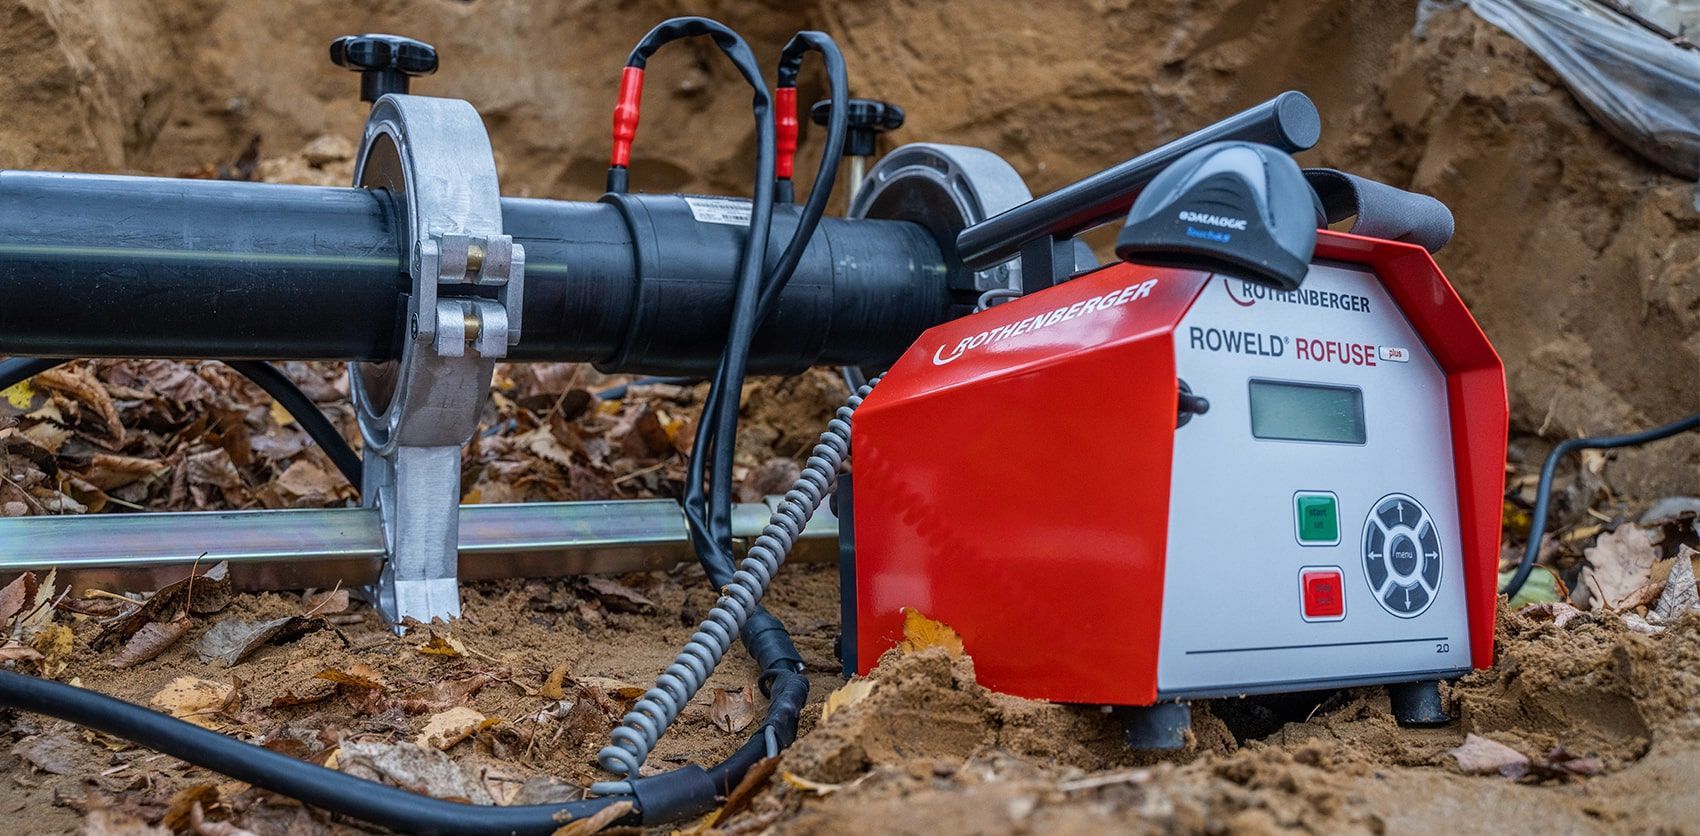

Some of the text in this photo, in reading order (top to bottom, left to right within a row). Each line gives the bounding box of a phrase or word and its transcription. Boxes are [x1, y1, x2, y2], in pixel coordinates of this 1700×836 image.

[1242, 281, 1371, 313] ROTHENBERGER
[950, 278, 1159, 355] ROTHENBERGER
[1295, 337, 1377, 367] ROFUSE
[1388, 348, 1403, 359] plus
[1395, 551, 1413, 559] menu
